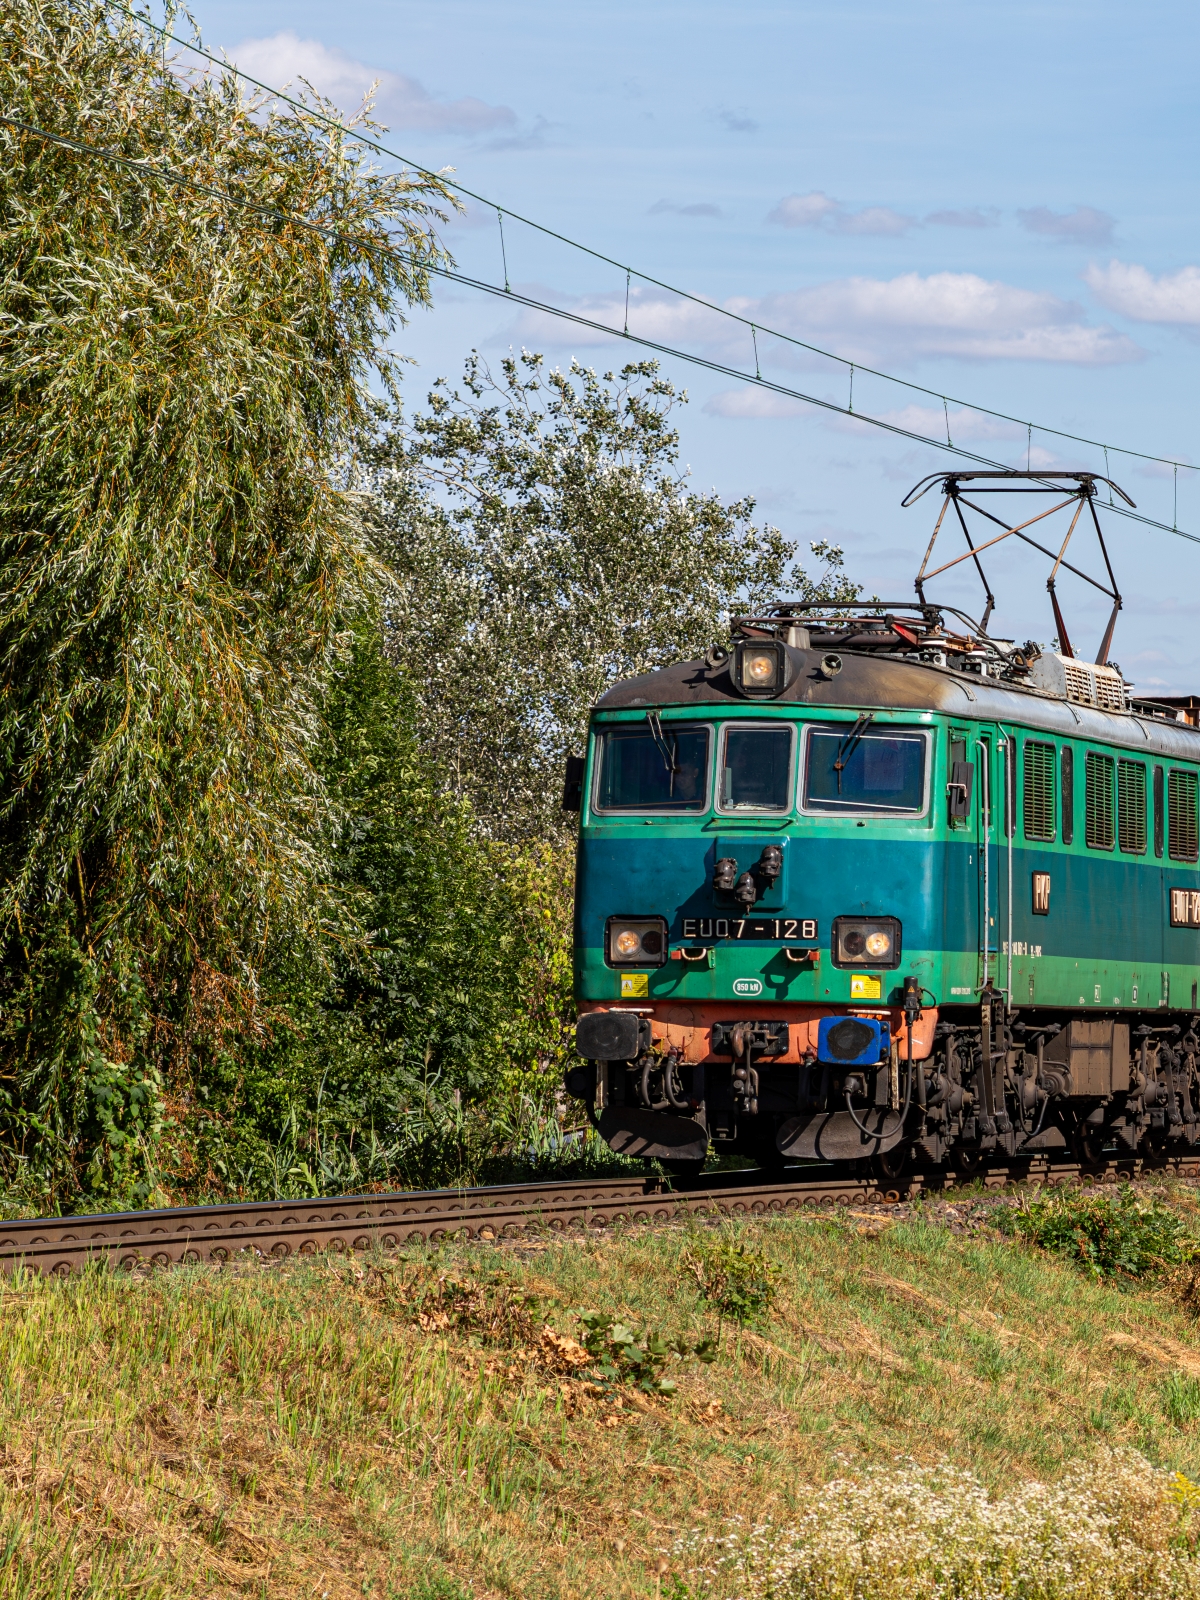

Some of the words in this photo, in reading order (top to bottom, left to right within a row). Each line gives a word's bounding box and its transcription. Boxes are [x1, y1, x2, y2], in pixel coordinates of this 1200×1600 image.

[1035, 875, 1050, 909] PKP
[736, 983, 749, 991] 850
[750, 983, 759, 991] kN
